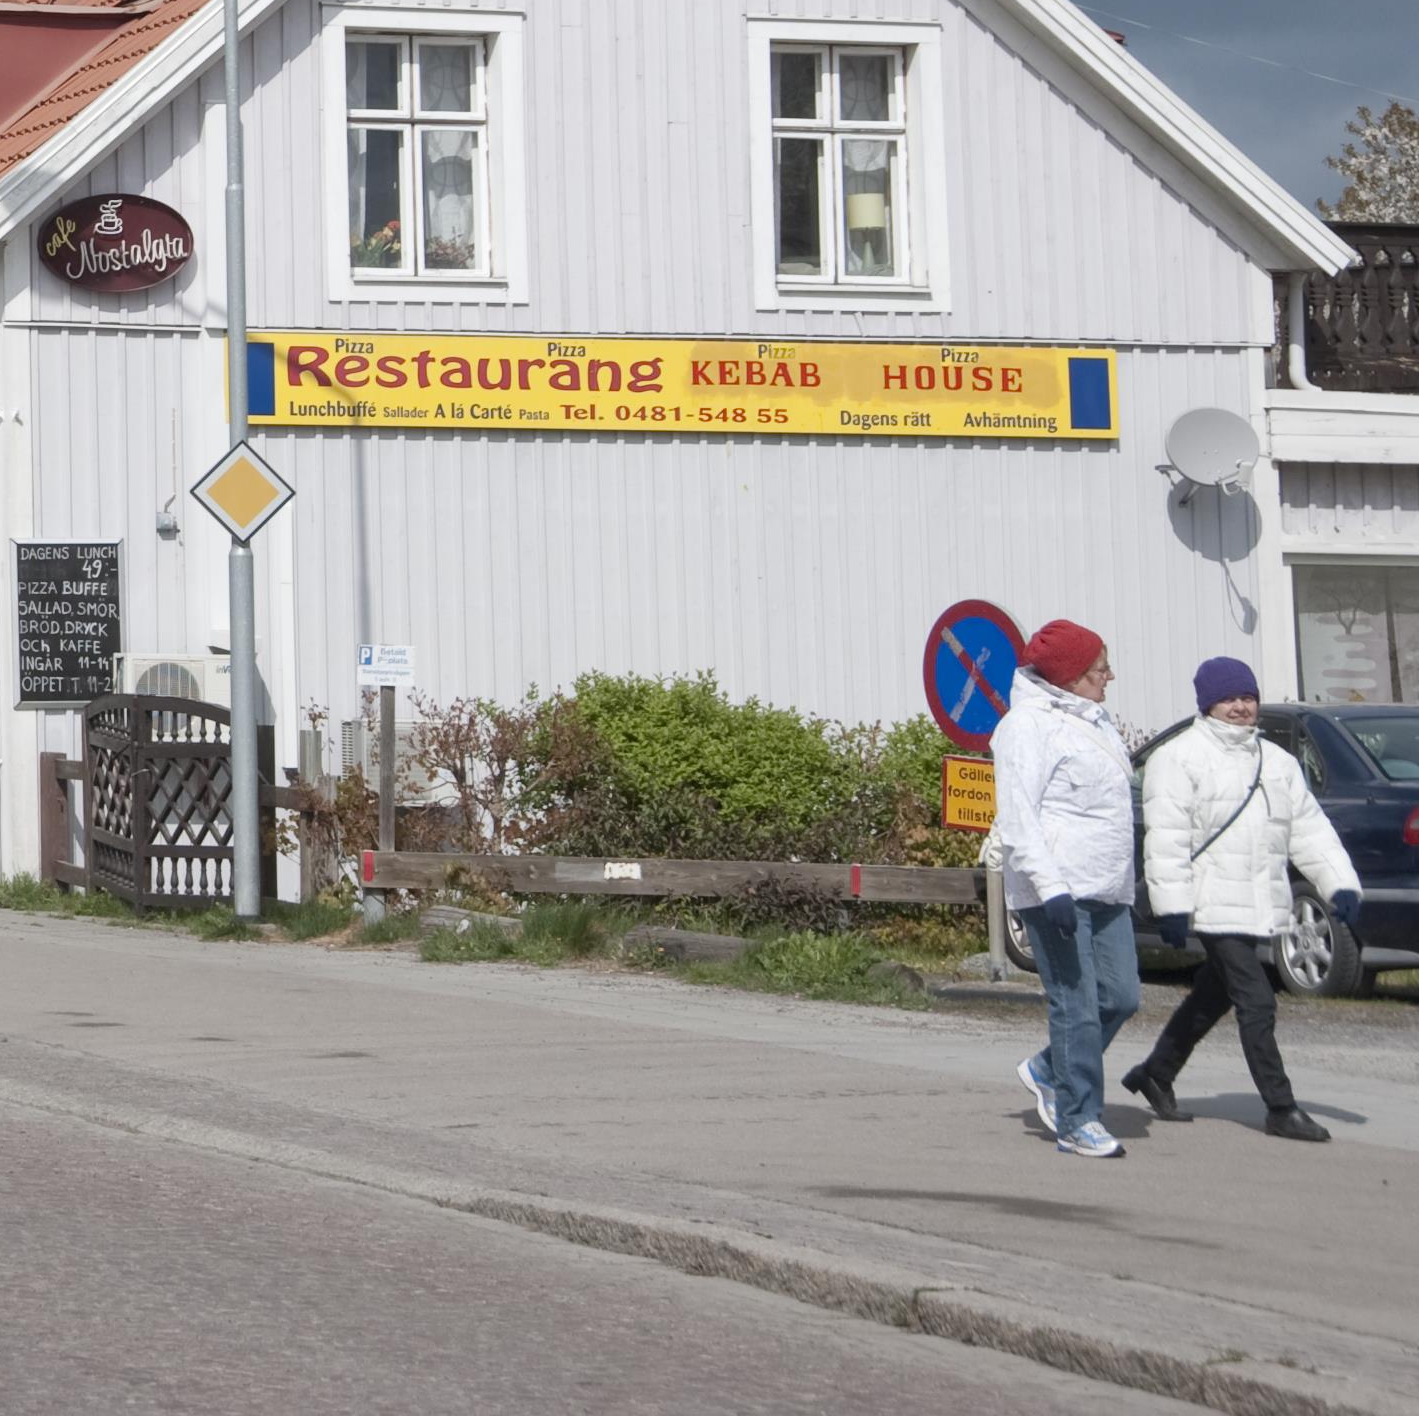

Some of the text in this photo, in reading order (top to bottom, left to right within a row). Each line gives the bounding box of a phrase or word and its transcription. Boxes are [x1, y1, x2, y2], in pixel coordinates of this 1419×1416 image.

[66, 228, 188, 279] Nostalgia
[335, 338, 374, 354] Pizza
[547, 342, 586, 358] Pizza
[758, 344, 796, 360] Pizza
[941, 347, 979, 363] Pizza
[287, 345, 1023, 393] Restaurang KEBAB HOUSE
[290, 400, 377, 419] Lunchbuffé
[383, 406, 429, 419] Sallader
[434, 403, 446, 419] A
[470, 404, 512, 420] Carté
[519, 408, 550, 421] Pasta
[560, 404, 604, 422] Tel.
[615, 405, 748, 423] 0481-548
[756, 408, 789, 424] 55
[840, 410, 898, 430] Dagens
[903, 412, 931, 427] rätt
[964, 412, 1058, 433] Avhämtning
[20, 547, 116, 560] DAGENS LUNCH
[19, 582, 57, 595] PIZZA
[60, 639, 102, 654] KAFFE
[21, 653, 64, 671] INGÅR
[87, 676, 112, 693] 11-2
[948, 785, 992, 801] fordon
